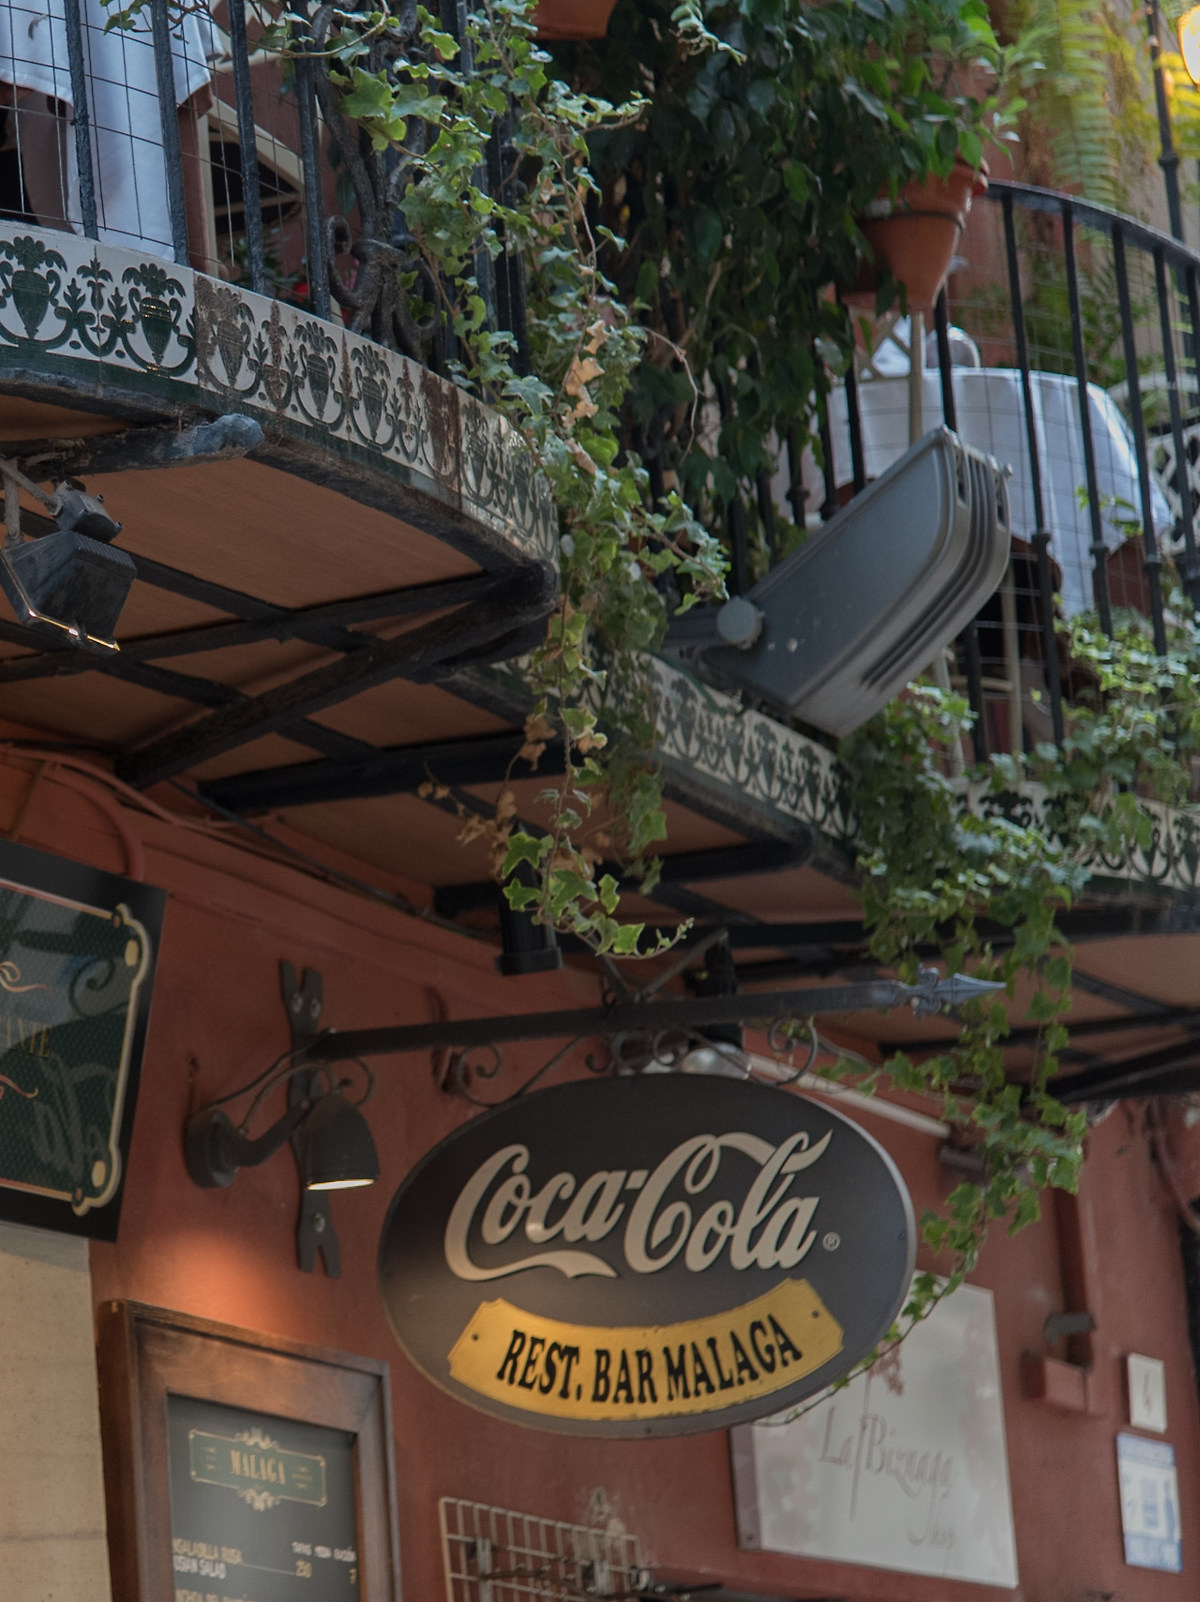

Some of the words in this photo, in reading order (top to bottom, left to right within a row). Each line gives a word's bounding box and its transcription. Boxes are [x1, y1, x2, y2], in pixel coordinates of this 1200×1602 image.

[444, 1129, 833, 1281] Coca-Cola
[496, 1329, 583, 1401] REST.
[591, 1348, 659, 1405] BAR
[662, 1313, 803, 1401] MALAGA
